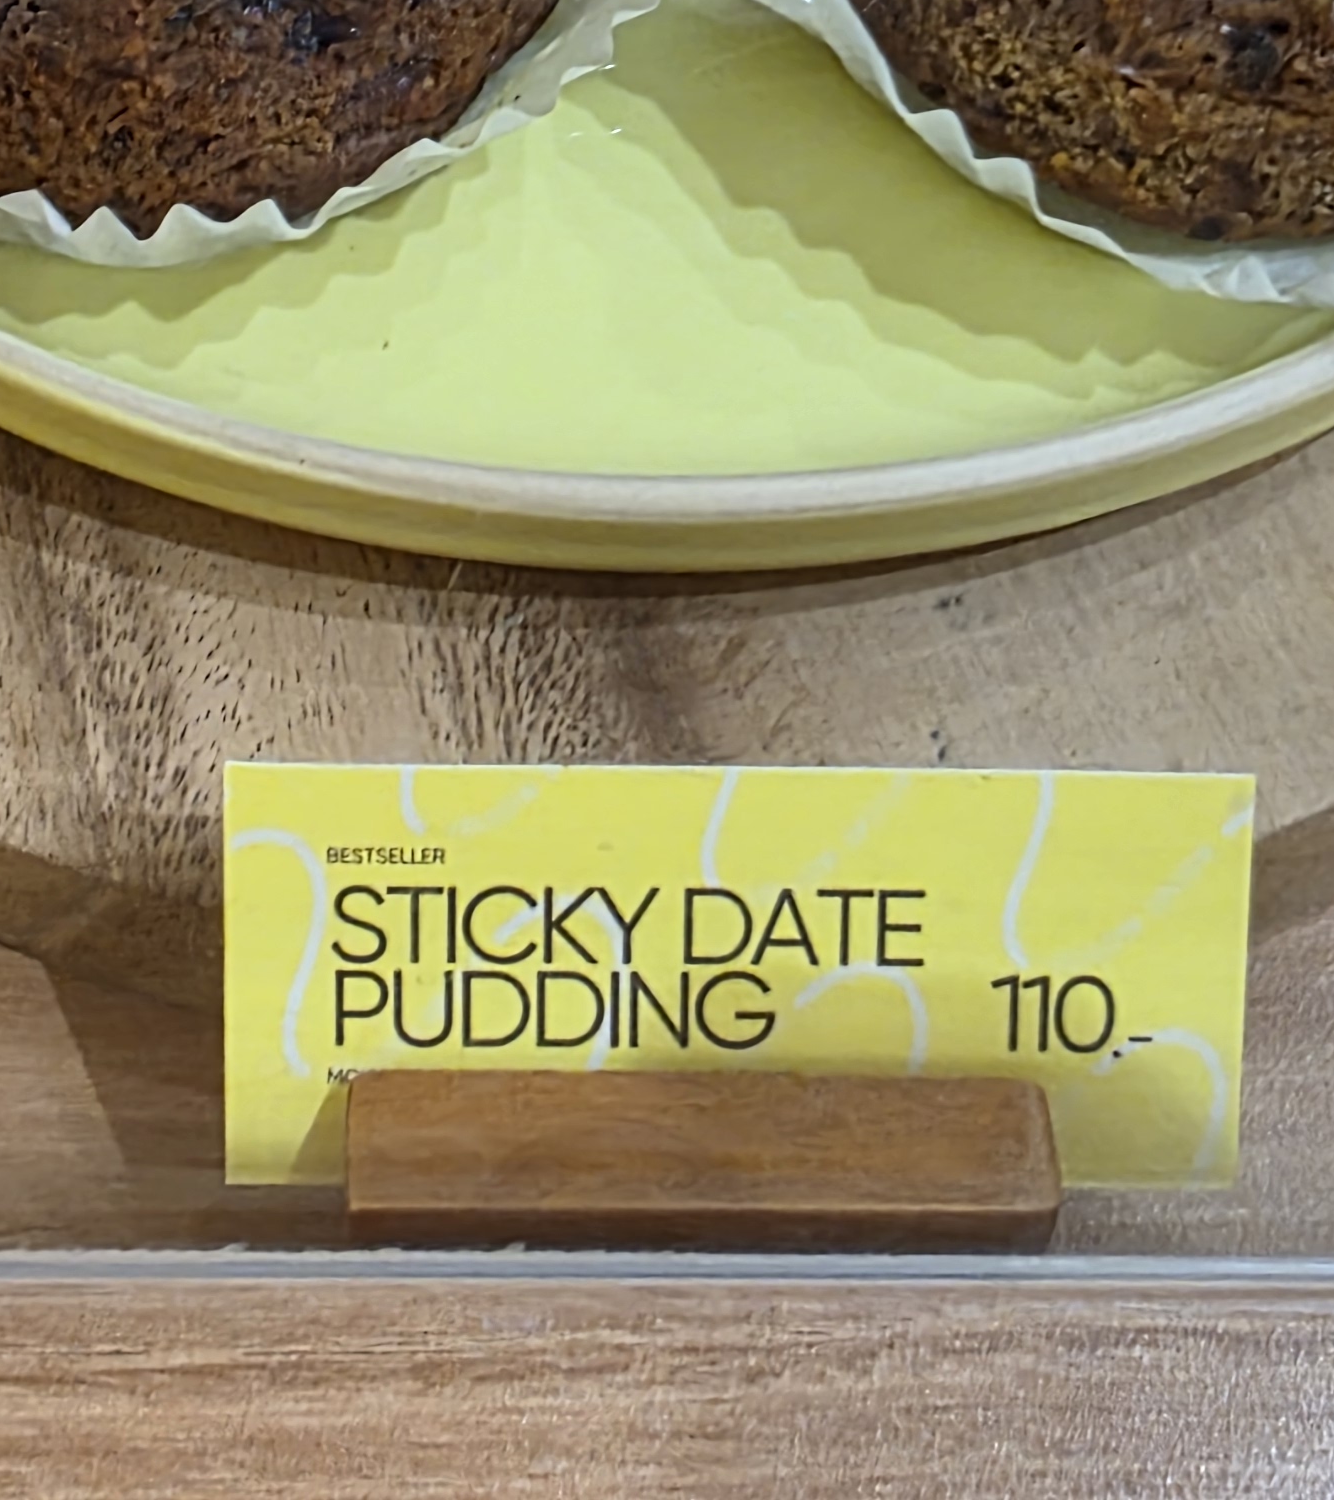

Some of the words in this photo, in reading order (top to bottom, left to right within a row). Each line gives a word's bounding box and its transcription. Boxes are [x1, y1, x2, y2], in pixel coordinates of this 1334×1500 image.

[326, 846, 446, 865] BESTSELLER
[331, 884, 661, 966] STICKY
[683, 887, 928, 968] DATE
[334, 969, 778, 1051] PUDDING
[990, 974, 1154, 1059] 110.-
